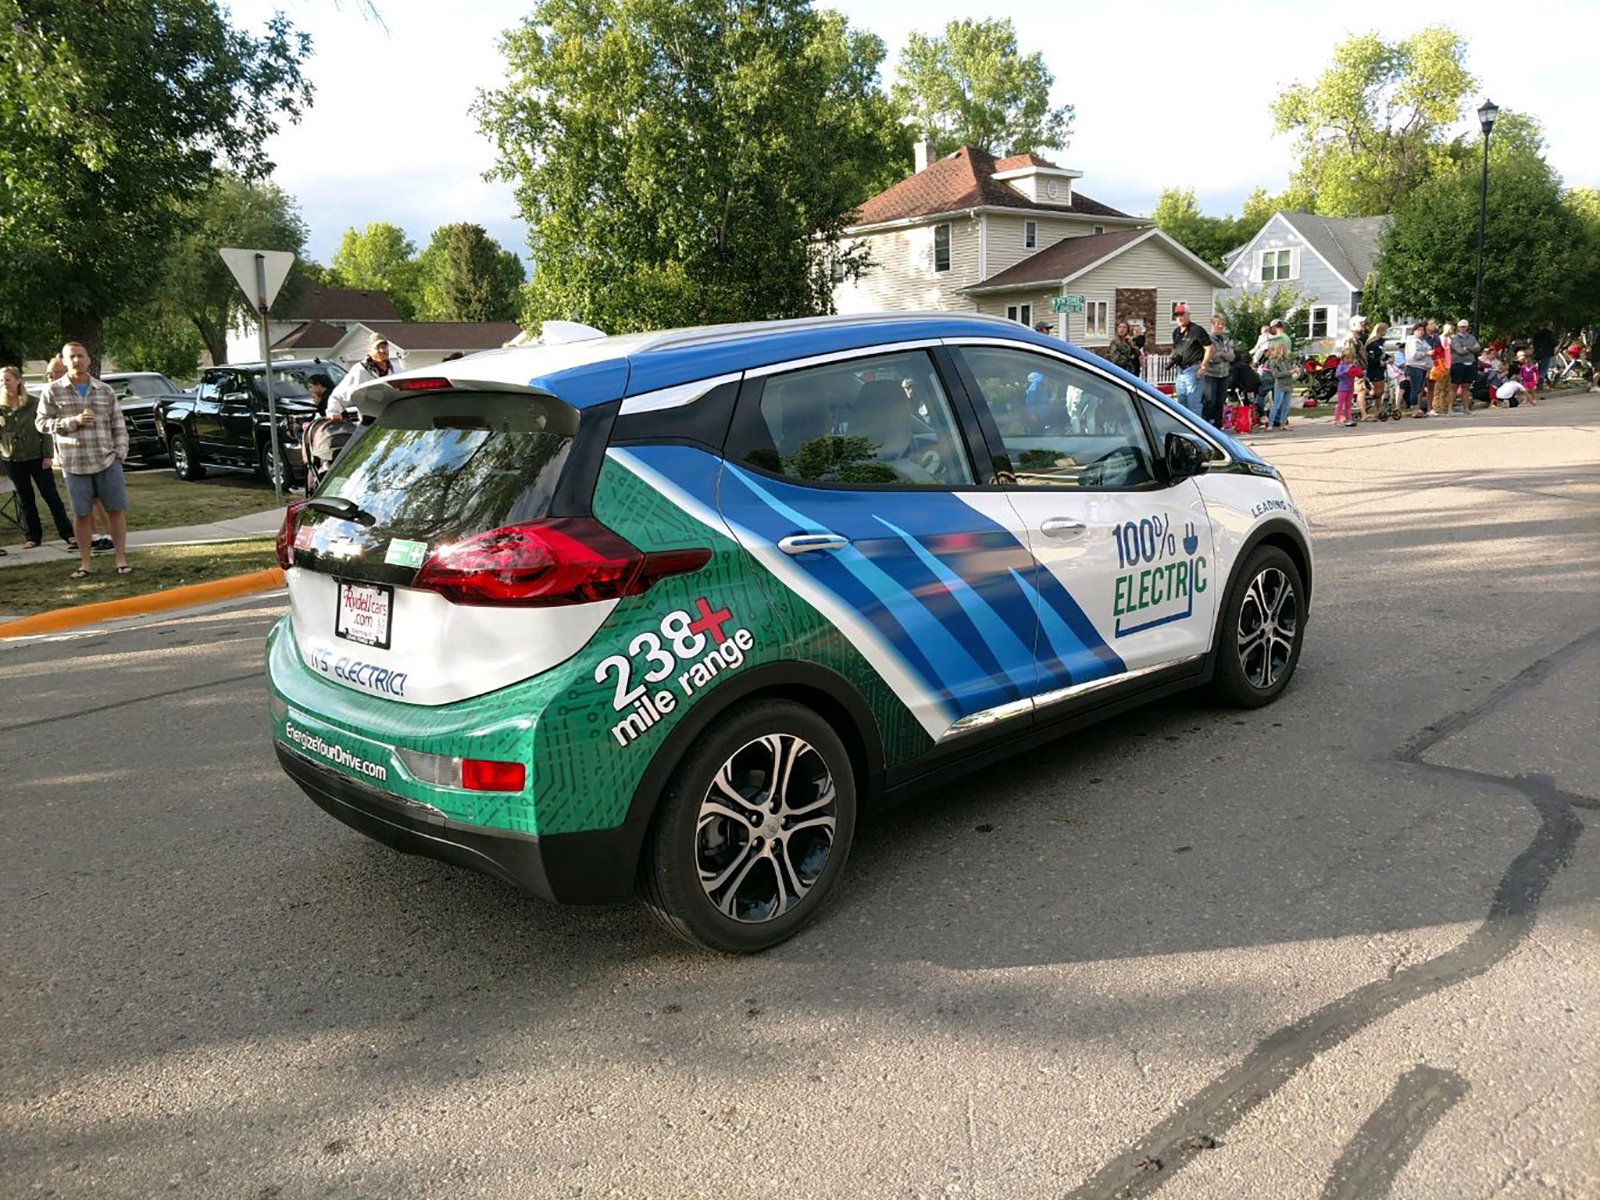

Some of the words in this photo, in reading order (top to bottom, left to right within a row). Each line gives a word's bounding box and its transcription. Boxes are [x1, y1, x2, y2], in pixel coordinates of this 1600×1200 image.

[1251, 500, 1287, 518] LEADING
[1112, 513, 1175, 569] 100%
[1113, 556, 1208, 617] ELECTRIC
[311, 647, 332, 672] IT'S
[335, 656, 408, 697] ELECTRIC!
[611, 690, 676, 747] mile
[678, 628, 754, 697] range
[285, 722, 387, 781] EnergizeYourDrive.com
